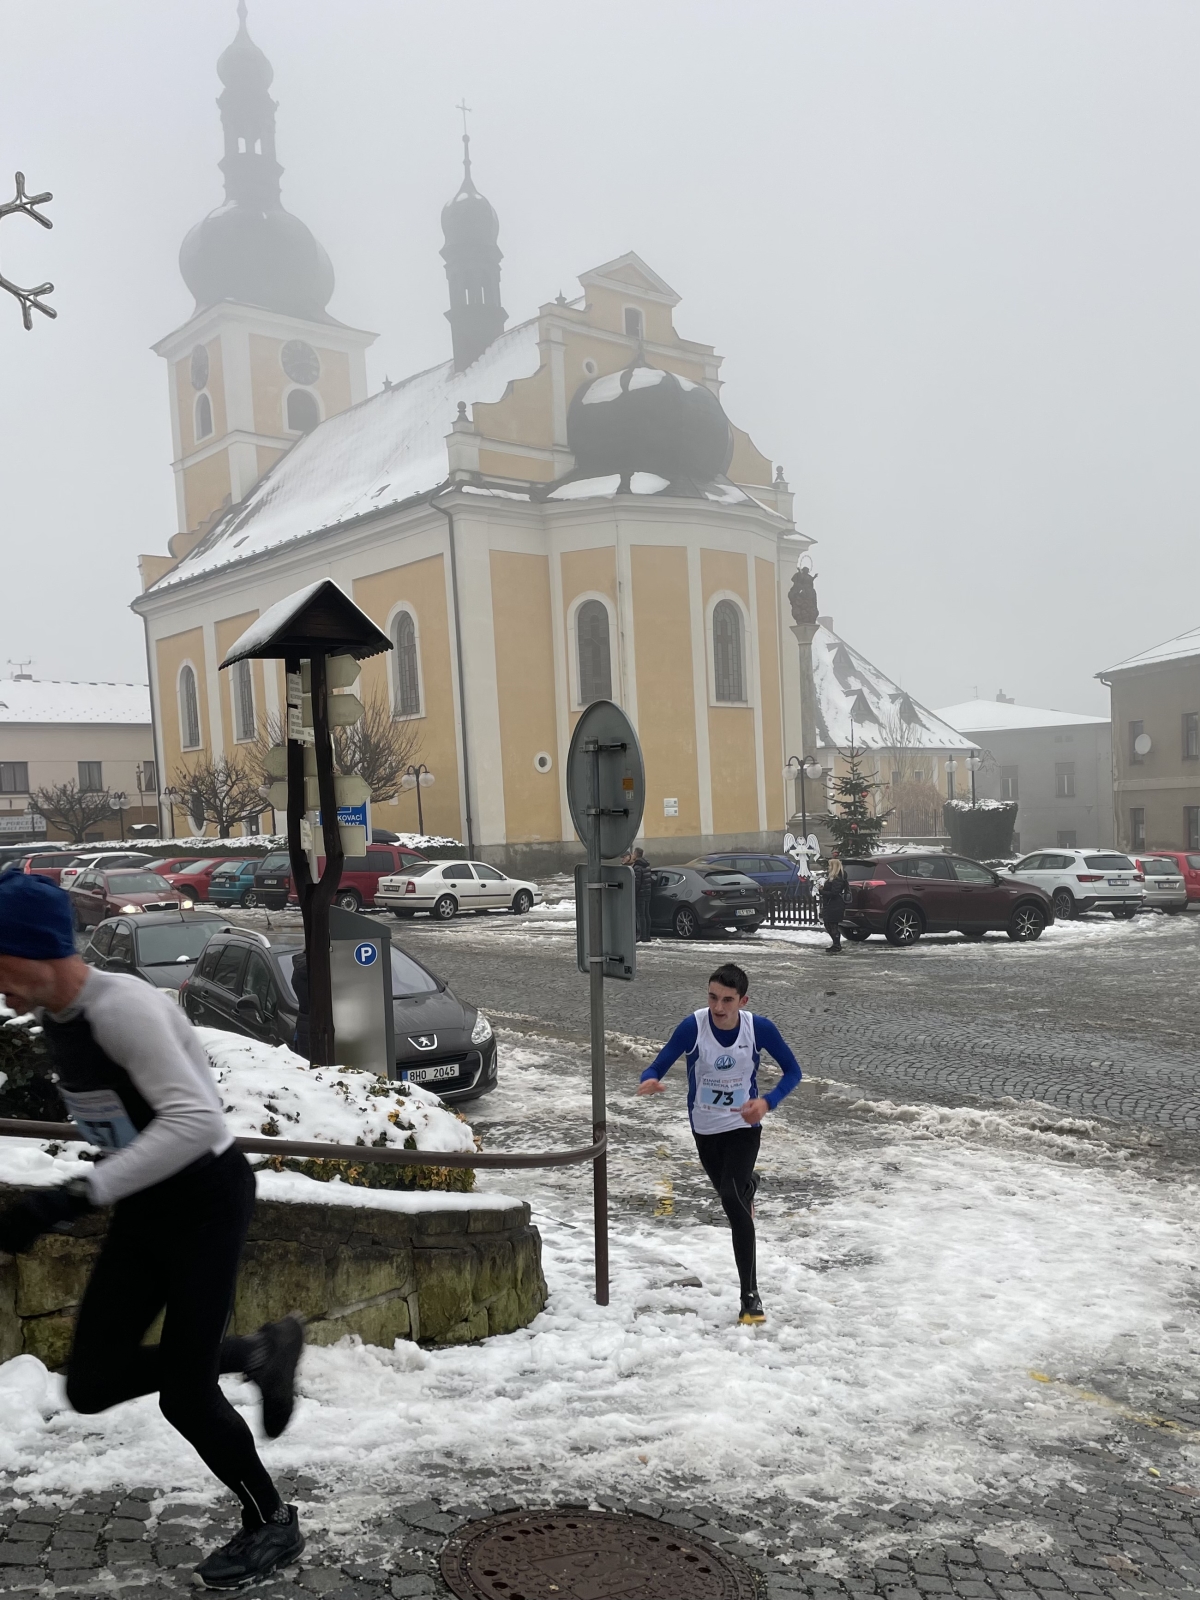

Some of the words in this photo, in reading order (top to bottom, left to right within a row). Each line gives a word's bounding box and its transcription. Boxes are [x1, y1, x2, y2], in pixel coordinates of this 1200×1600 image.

[337, 813, 362, 821] KOVACÍ
[361, 947, 372, 962] P
[433, 1065, 455, 1079] 2045
[712, 1089, 734, 1106] 73
